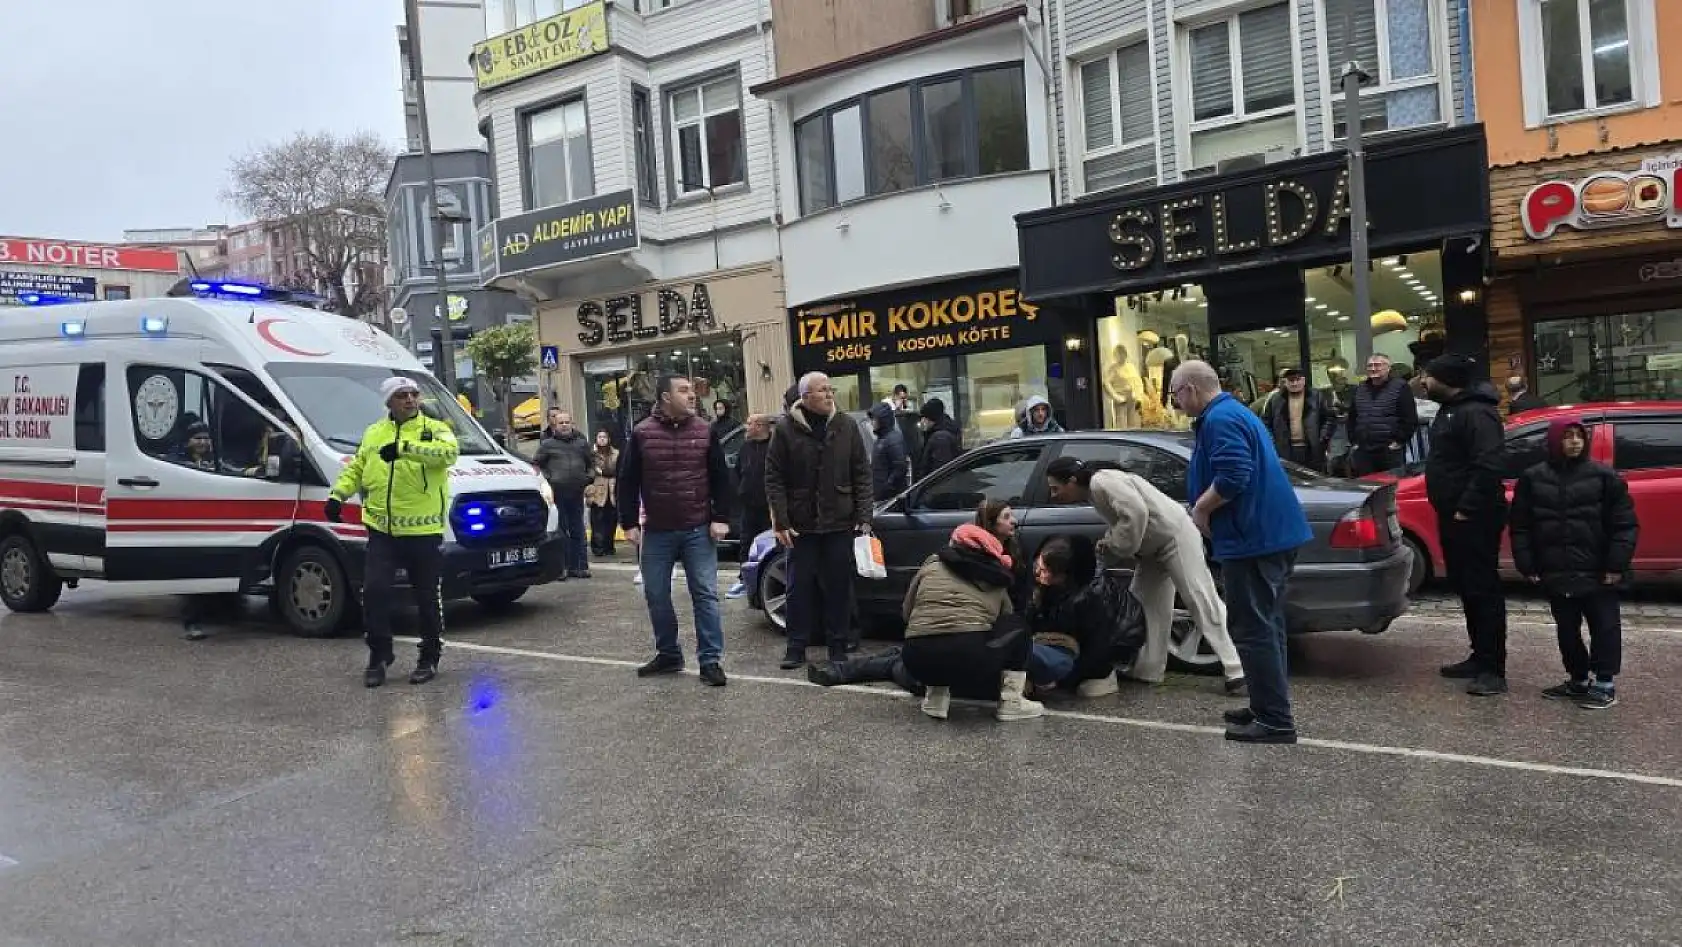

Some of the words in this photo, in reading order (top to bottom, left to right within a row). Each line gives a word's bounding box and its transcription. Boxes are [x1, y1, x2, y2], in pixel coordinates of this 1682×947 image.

[509, 47, 549, 70] SANAT
[532, 209, 595, 244] ALDEMİR
[599, 202, 632, 230] YAPI
[1109, 169, 1374, 270] SELDA
[26, 243, 121, 267] NOTER
[577, 283, 717, 346] SELDA
[797, 304, 878, 346] İZMİR
[826, 343, 872, 363] SÖĞÜŞ
[897, 334, 955, 353] KOSOVA
[958, 325, 1011, 344] KÖFTE
[14, 393, 70, 416] BAKANLIĞI
[14, 416, 52, 439] SAĞLIK
